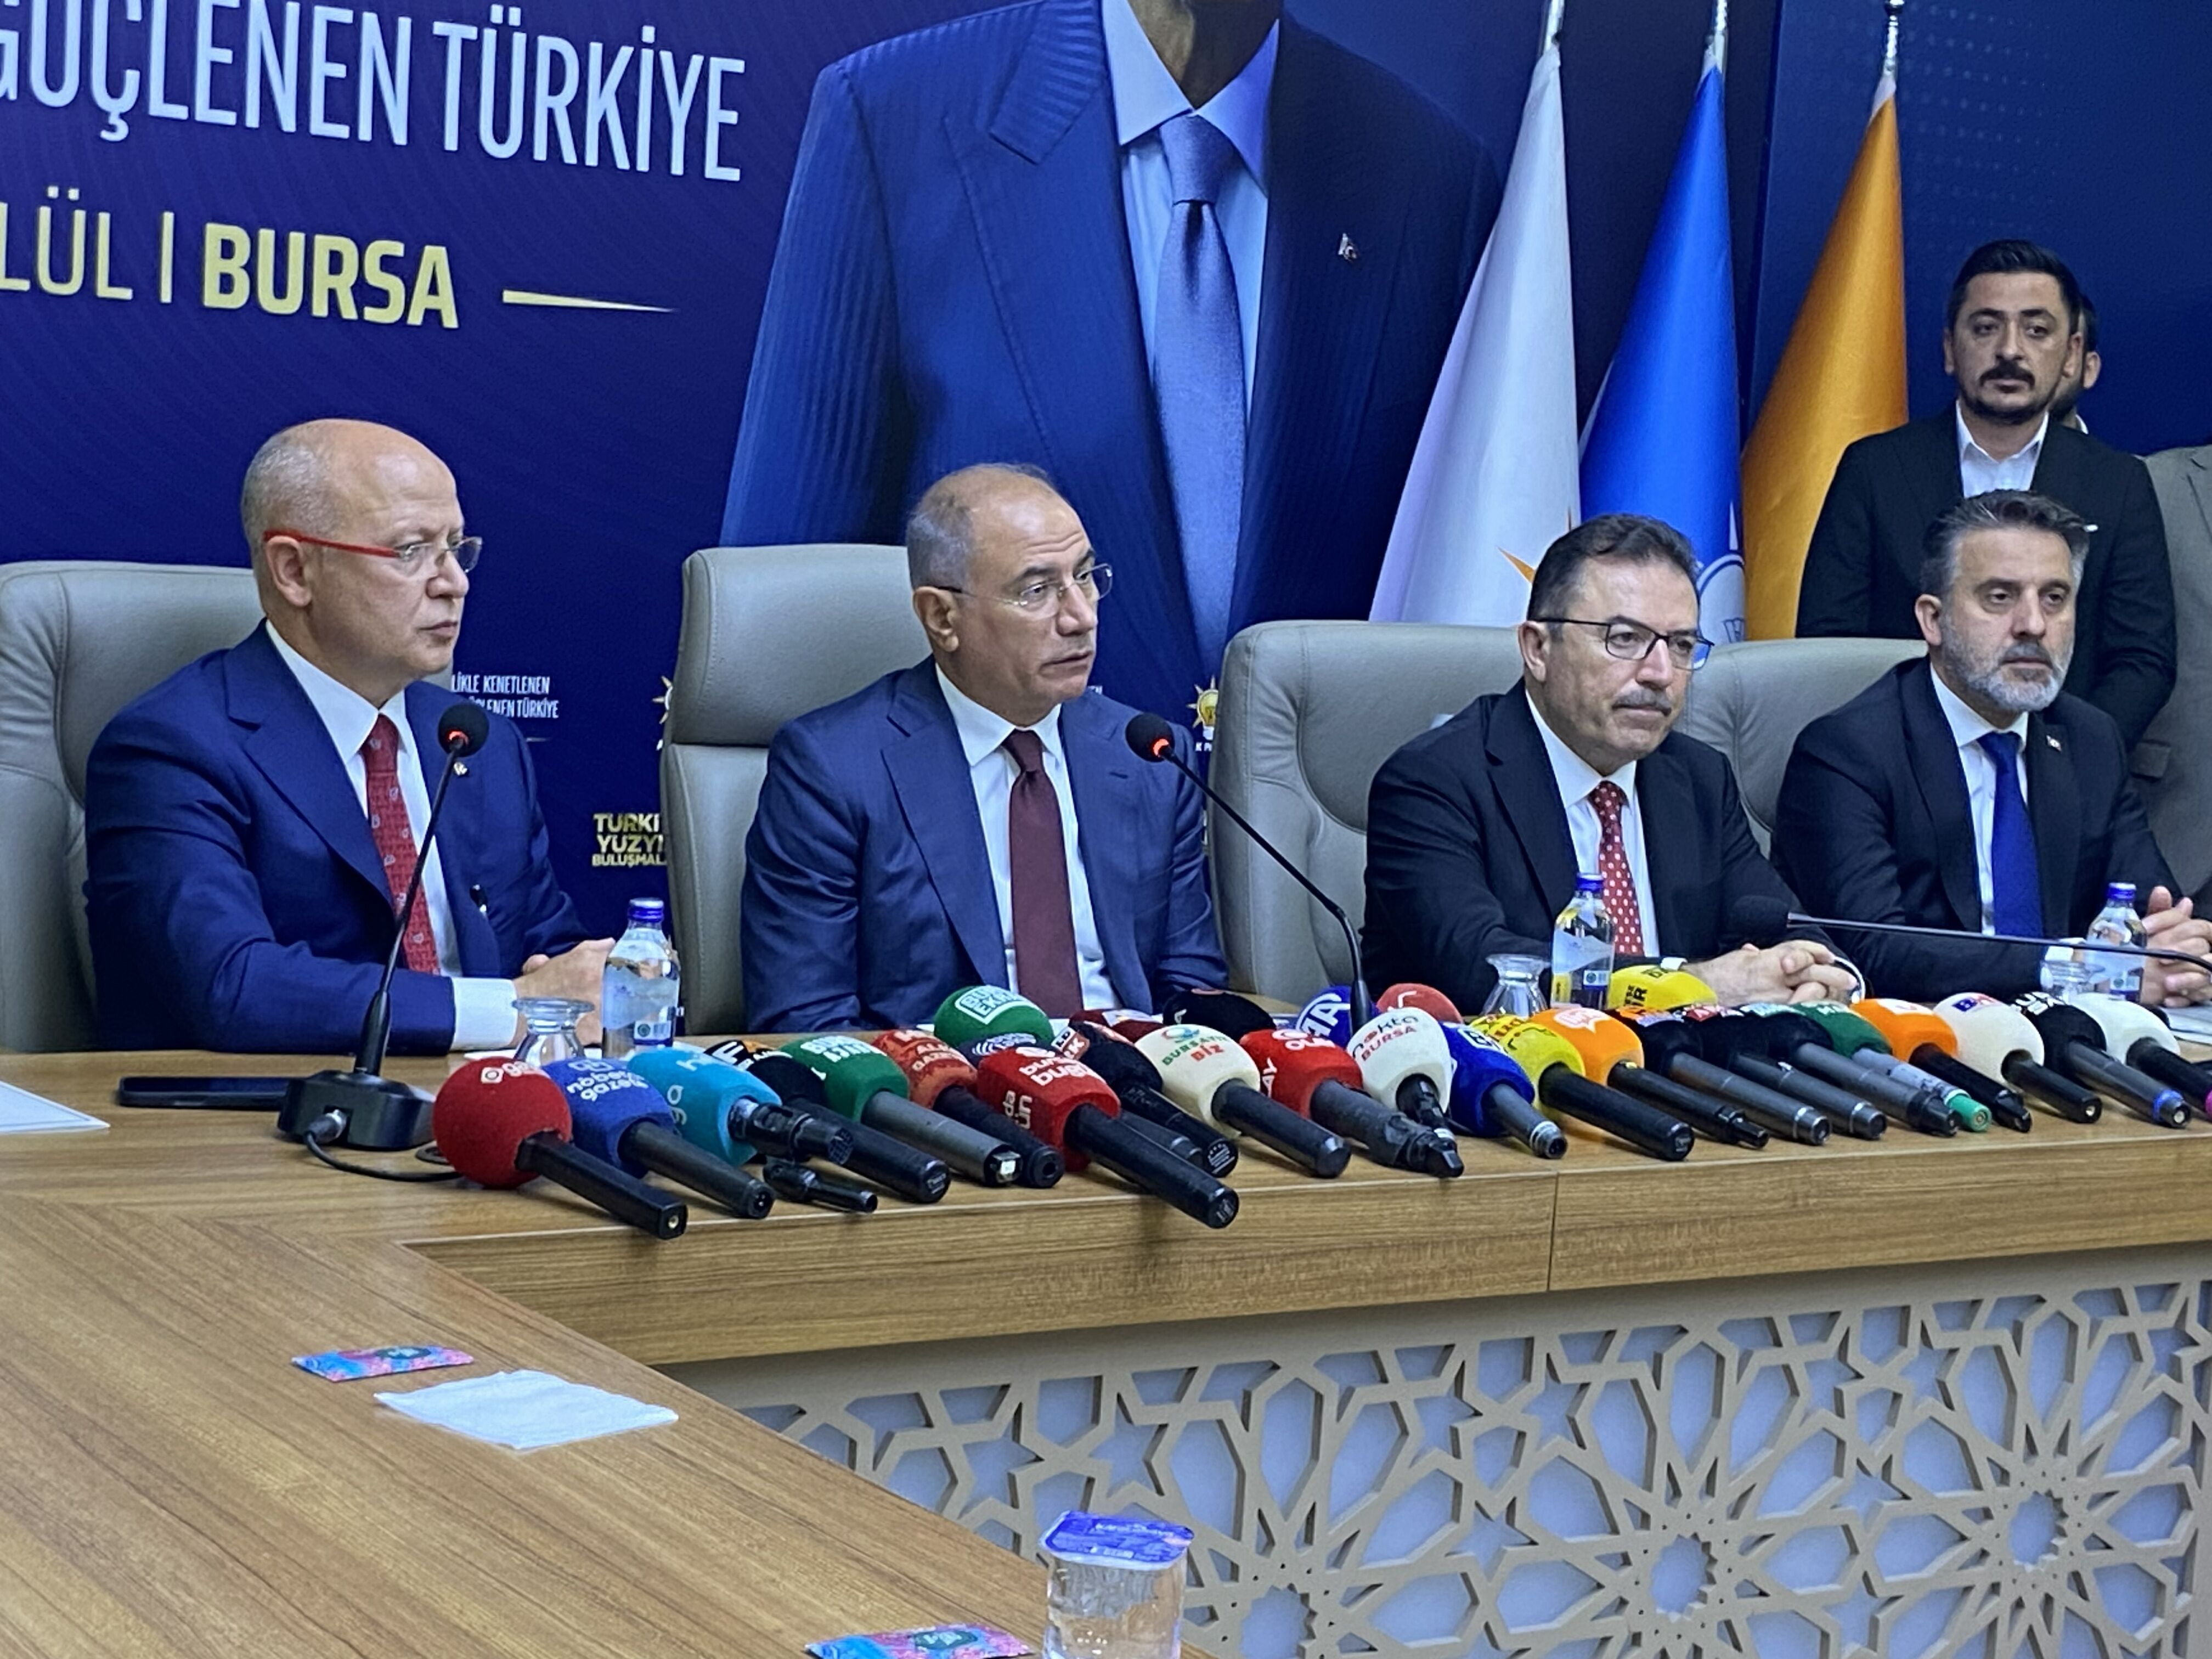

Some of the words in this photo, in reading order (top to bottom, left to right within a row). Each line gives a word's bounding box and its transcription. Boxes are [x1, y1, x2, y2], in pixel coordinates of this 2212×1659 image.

[433, 4, 745, 182] TÜRKİYE
[203, 222, 459, 329] BURSA
[483, 675, 550, 695] KENETLENEN
[517, 697, 560, 719] TÜRKİYE
[1361, 1026, 1417, 1061] BURSA
